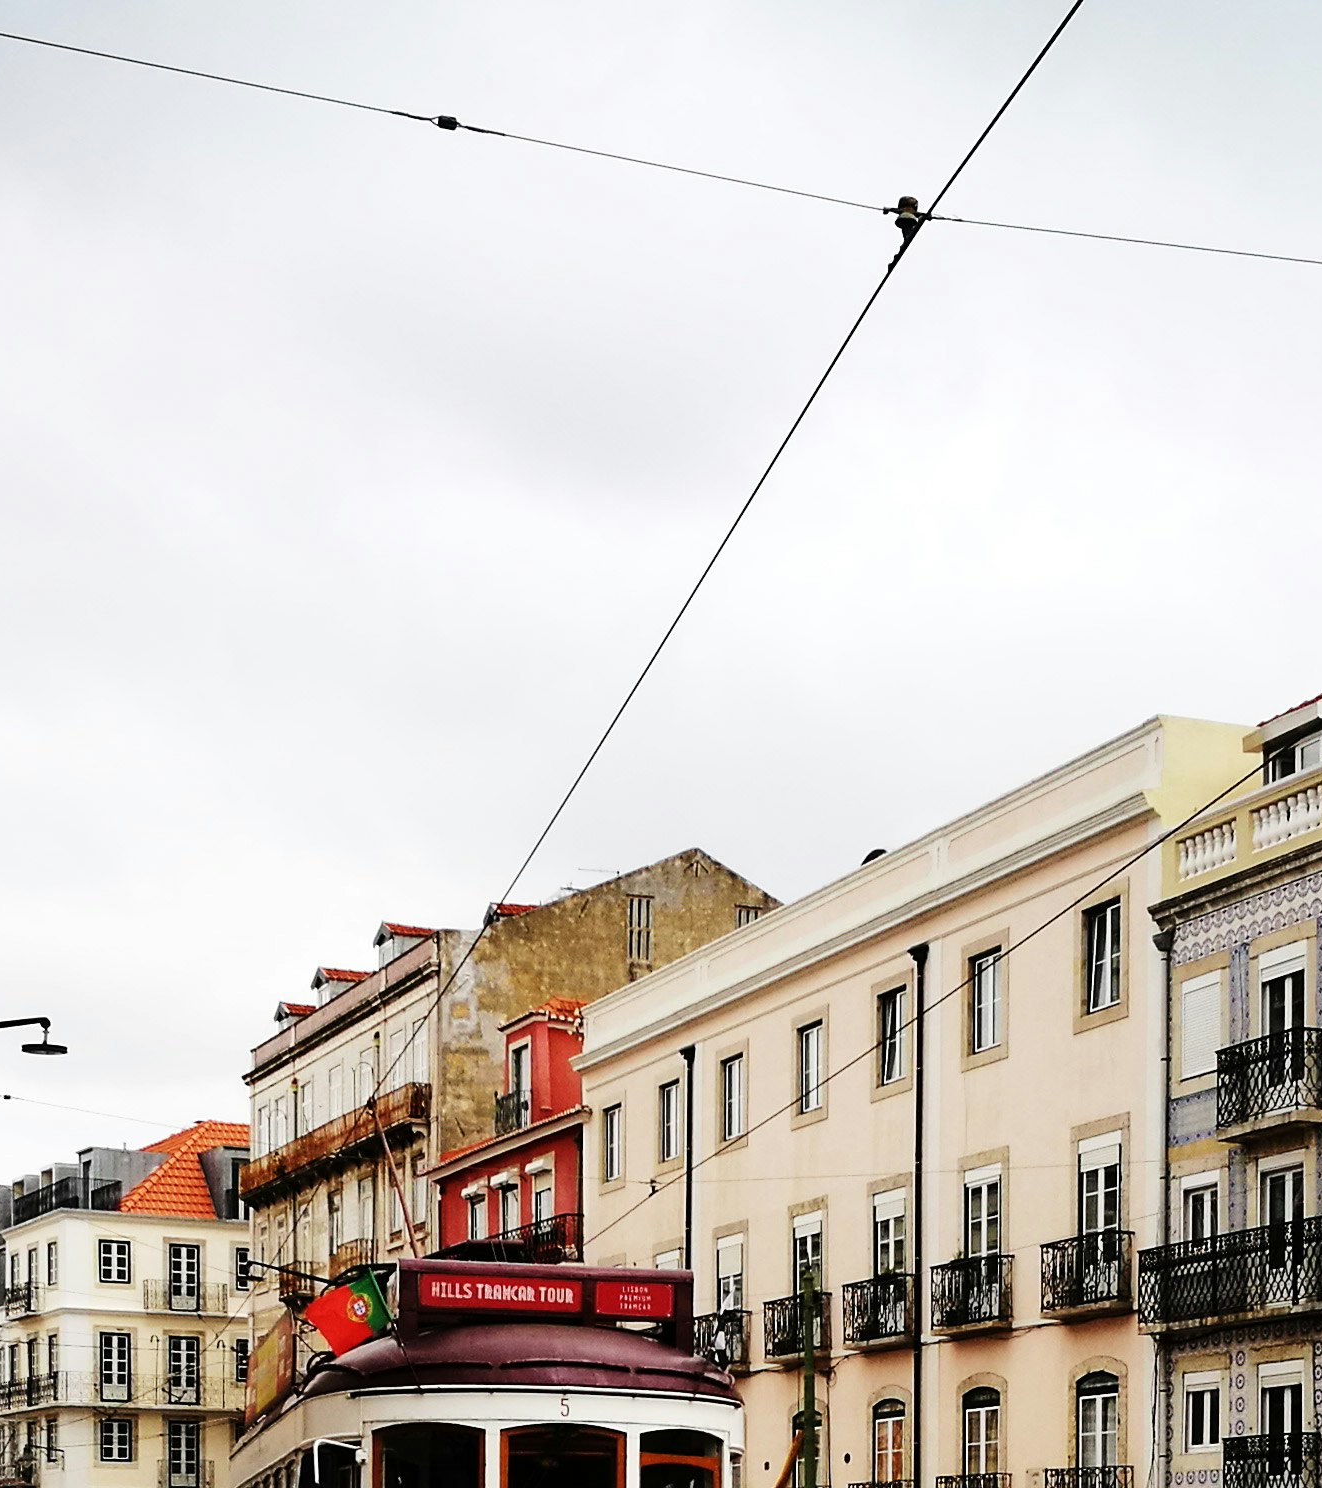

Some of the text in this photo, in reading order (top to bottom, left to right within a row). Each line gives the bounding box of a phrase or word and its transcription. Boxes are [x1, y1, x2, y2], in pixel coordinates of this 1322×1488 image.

[431, 1281, 575, 1304] HILLS TRAMCAR TOUR
[622, 1285, 648, 1294] LISBON
[619, 1294, 652, 1302] PREMIUM
[620, 1302, 652, 1311] TRAMCAR
[560, 1398, 570, 1417] 5
